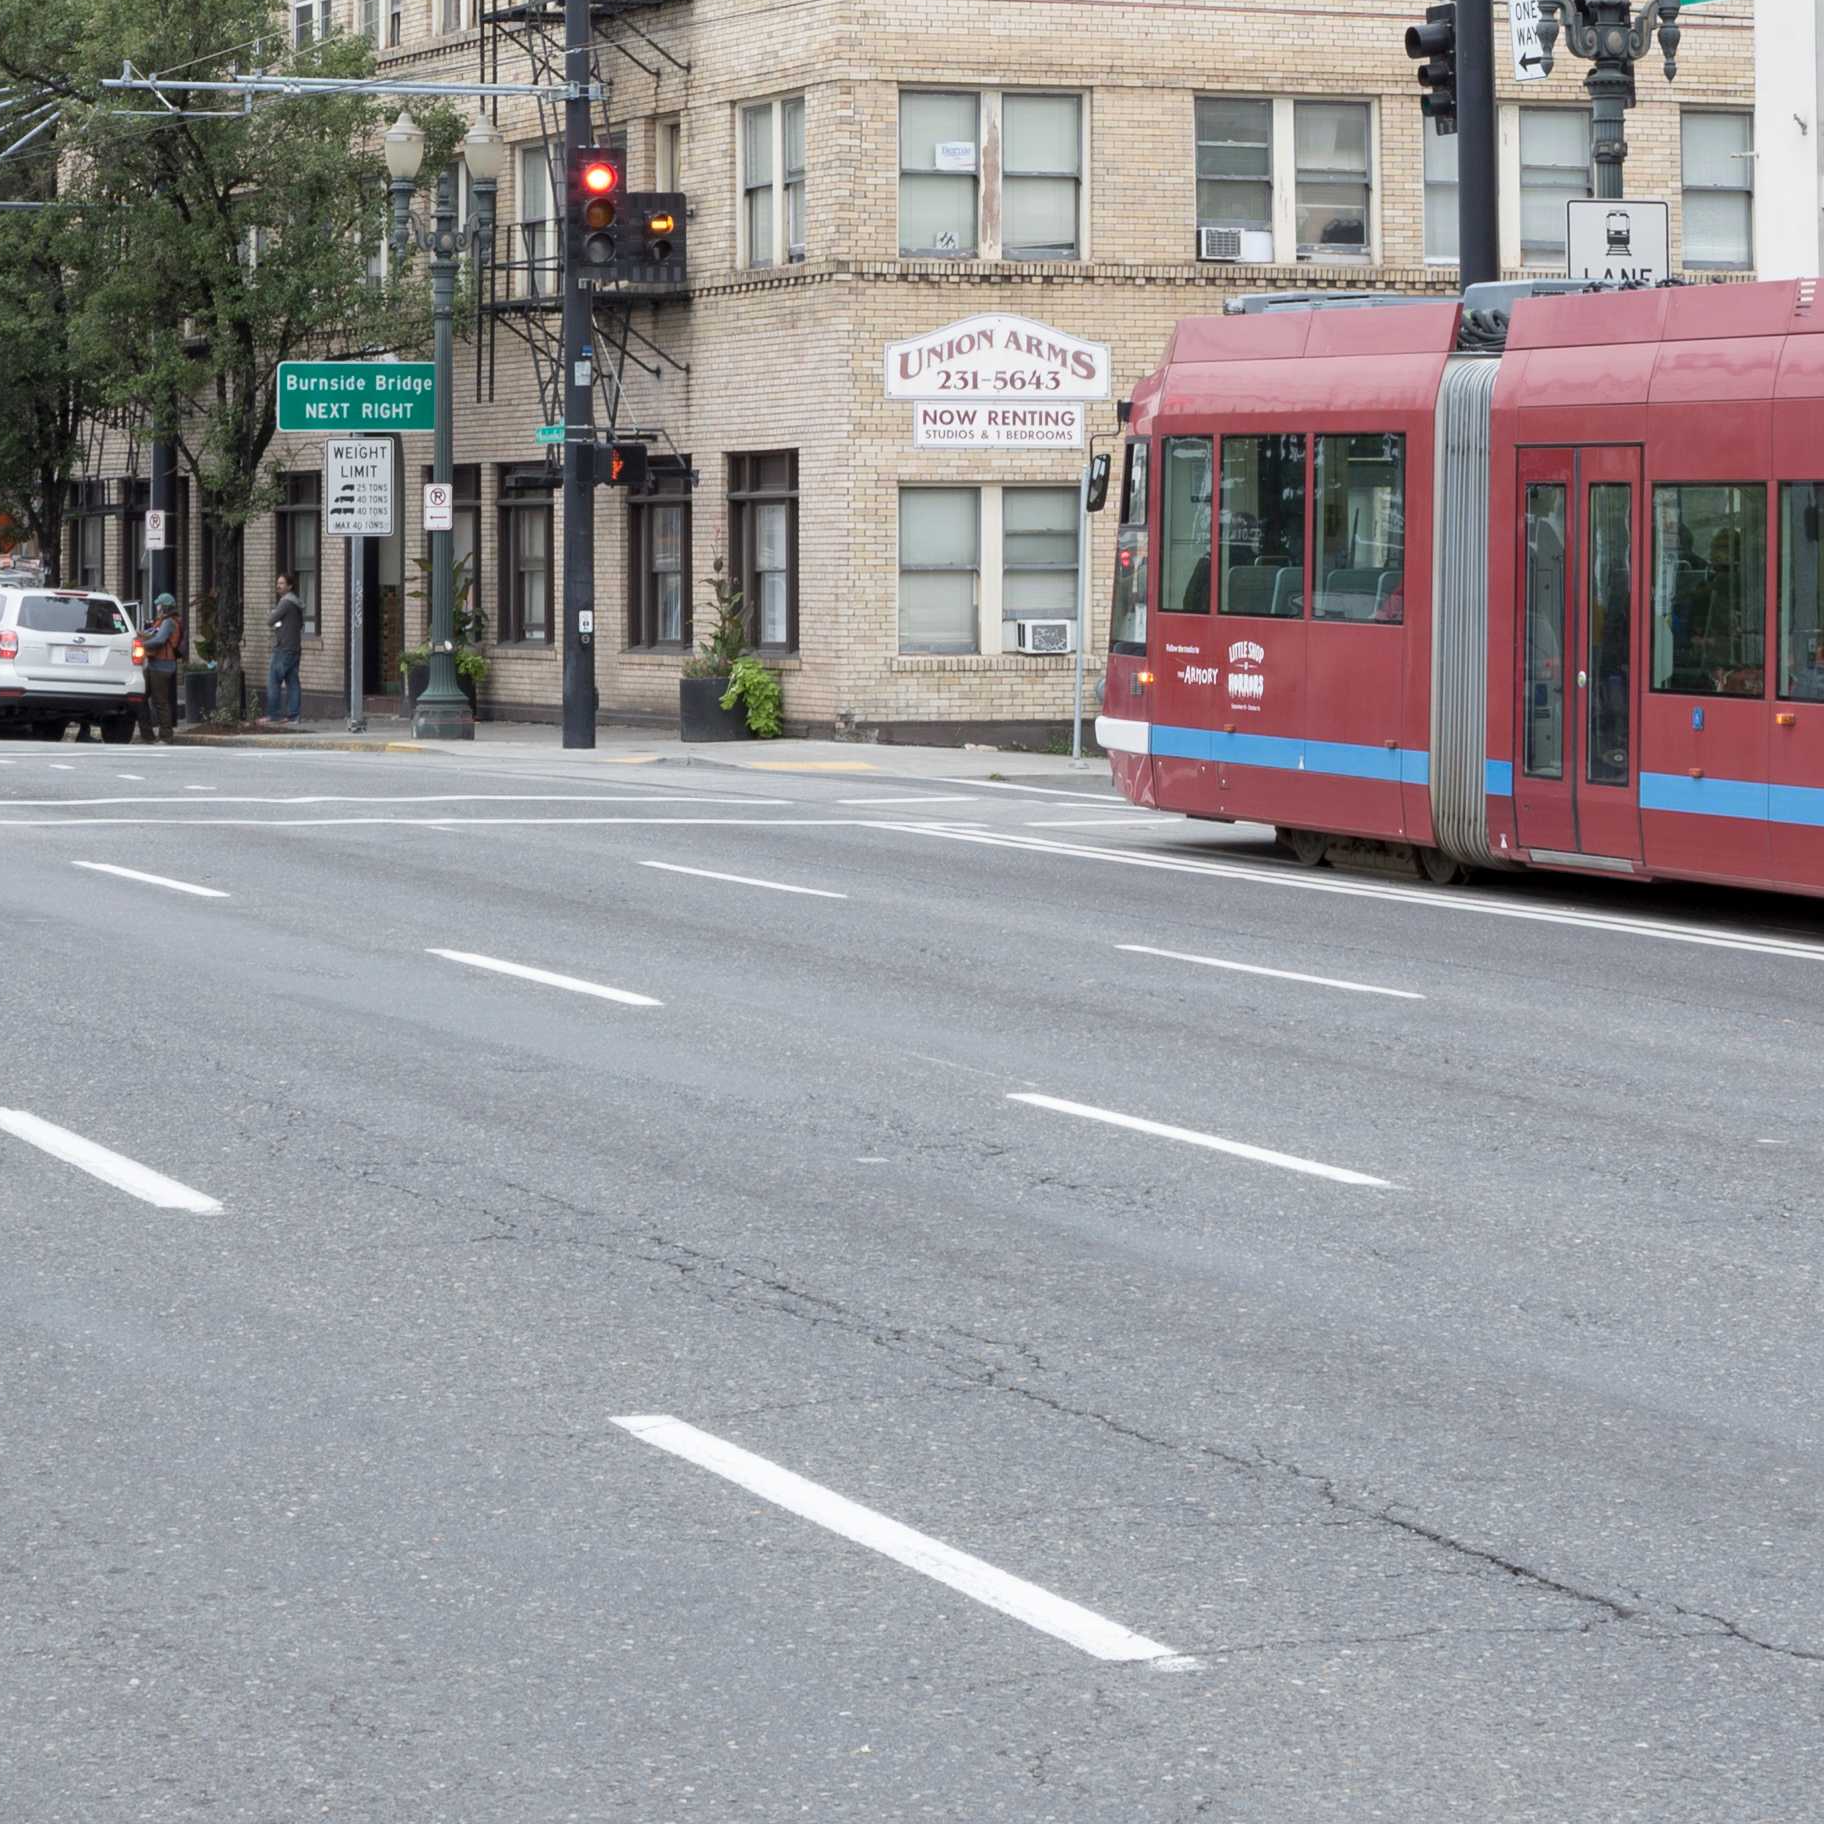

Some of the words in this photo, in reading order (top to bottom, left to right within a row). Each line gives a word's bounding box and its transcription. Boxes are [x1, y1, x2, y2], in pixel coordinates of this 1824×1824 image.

[1515, 0, 1537, 21] ONE
[898, 328, 996, 381] UNION
[1004, 329, 1097, 381] ARMS
[286, 374, 366, 391] Burnside
[376, 374, 433, 395] Bridge
[936, 369, 1062, 391] 231-5643
[305, 402, 350, 419] NEXT
[362, 402, 414, 419] RIGHT
[922, 409, 978, 425] NOW
[987, 410, 1076, 427] RENTING
[925, 429, 975, 440] STUDIOS
[981, 431, 989, 439] &
[1006, 430, 1073, 441] BEDROOMS
[334, 446, 387, 460] WEIGHT
[341, 465, 377, 478] LIMIT
[369, 483, 388, 492] TONS
[369, 495, 388, 504] TONS
[369, 507, 388, 516] TONS
[1183, 665, 1218, 685] ARMORY
